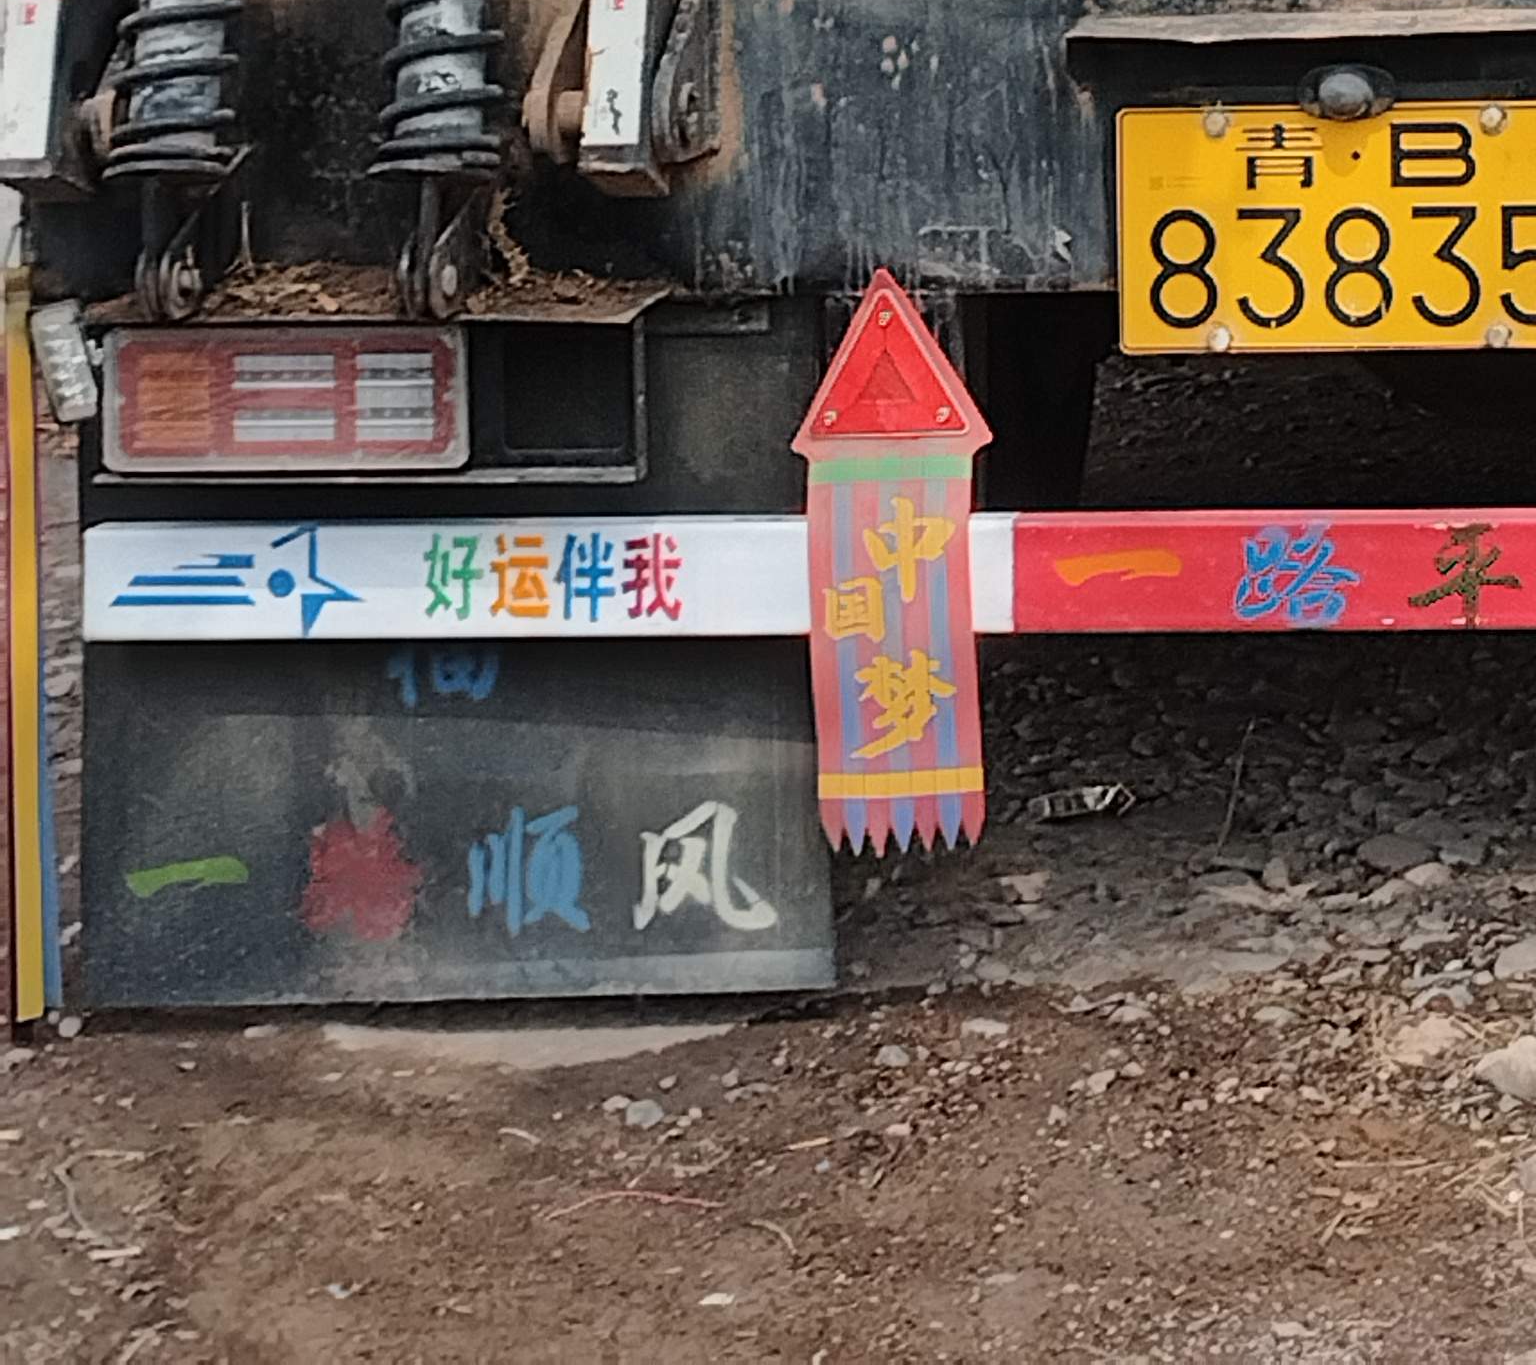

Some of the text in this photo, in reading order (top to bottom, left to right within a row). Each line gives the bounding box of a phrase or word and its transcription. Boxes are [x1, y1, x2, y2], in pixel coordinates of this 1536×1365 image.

[423, 531, 683, 623] 好运伴我
[822, 496, 957, 760] 中国梦
